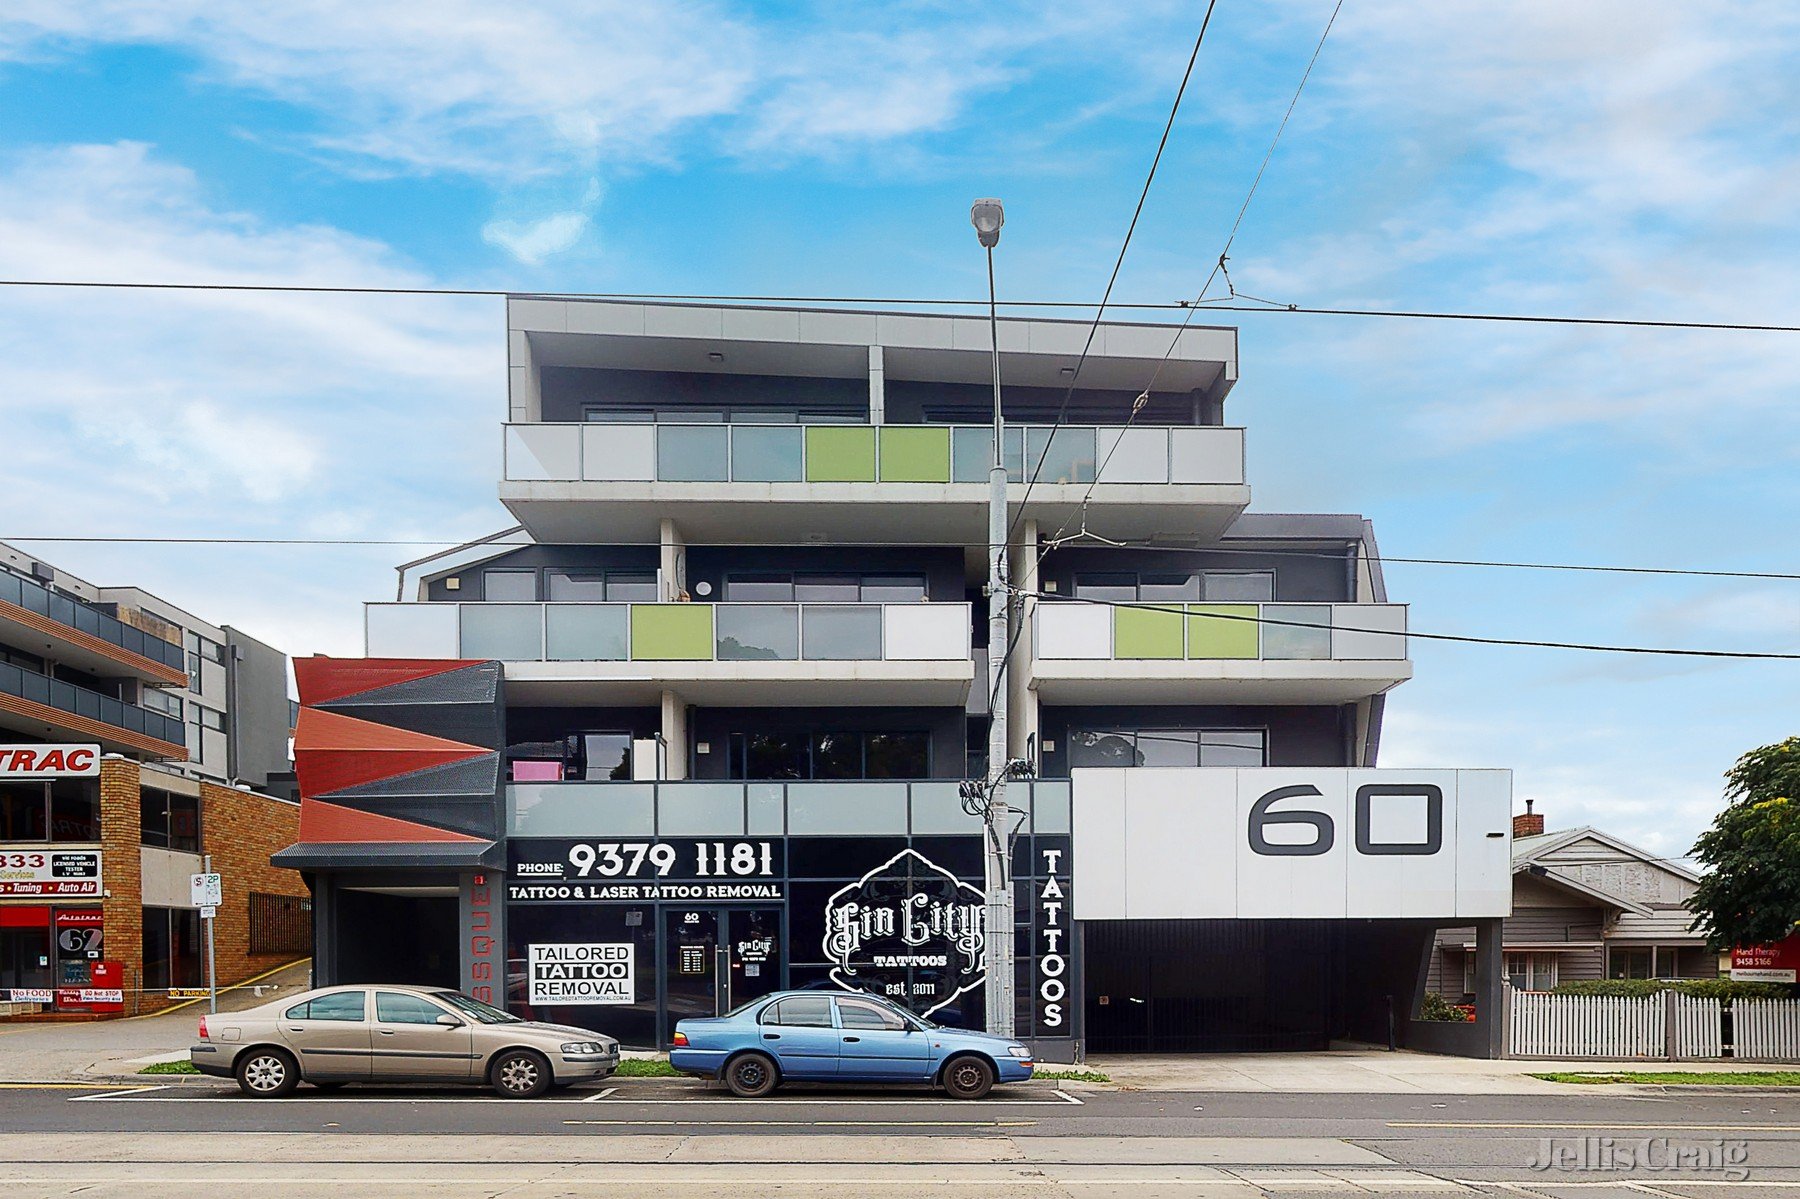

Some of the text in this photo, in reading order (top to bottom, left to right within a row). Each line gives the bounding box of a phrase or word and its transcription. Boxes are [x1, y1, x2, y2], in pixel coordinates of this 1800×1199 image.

[1248, 784, 1443, 856] 60
[517, 842, 773, 877] PHONE: 9379 1181
[13, 883, 42, 893] Tuning
[57, 883, 79, 892] Auto
[81, 882, 95, 892] Air
[510, 885, 781, 899] TATTOO & LASER TATTOO REMOVAL
[684, 912, 699, 920] 60
[59, 928, 103, 951] 62
[1040, 849, 1065, 1027] TATTOOS
[534, 947, 629, 960] TAILORED
[1736, 947, 1781, 958] Hand Therapy
[873, 955, 947, 967] TATTOOS
[1736, 957, 1754, 966] 9458
[537, 963, 627, 979] TATTOO
[13, 989, 24, 997] No
[26, 989, 51, 997] FOOD
[534, 982, 629, 996] REMOVAL
[912, 983, 935, 995] 2011
